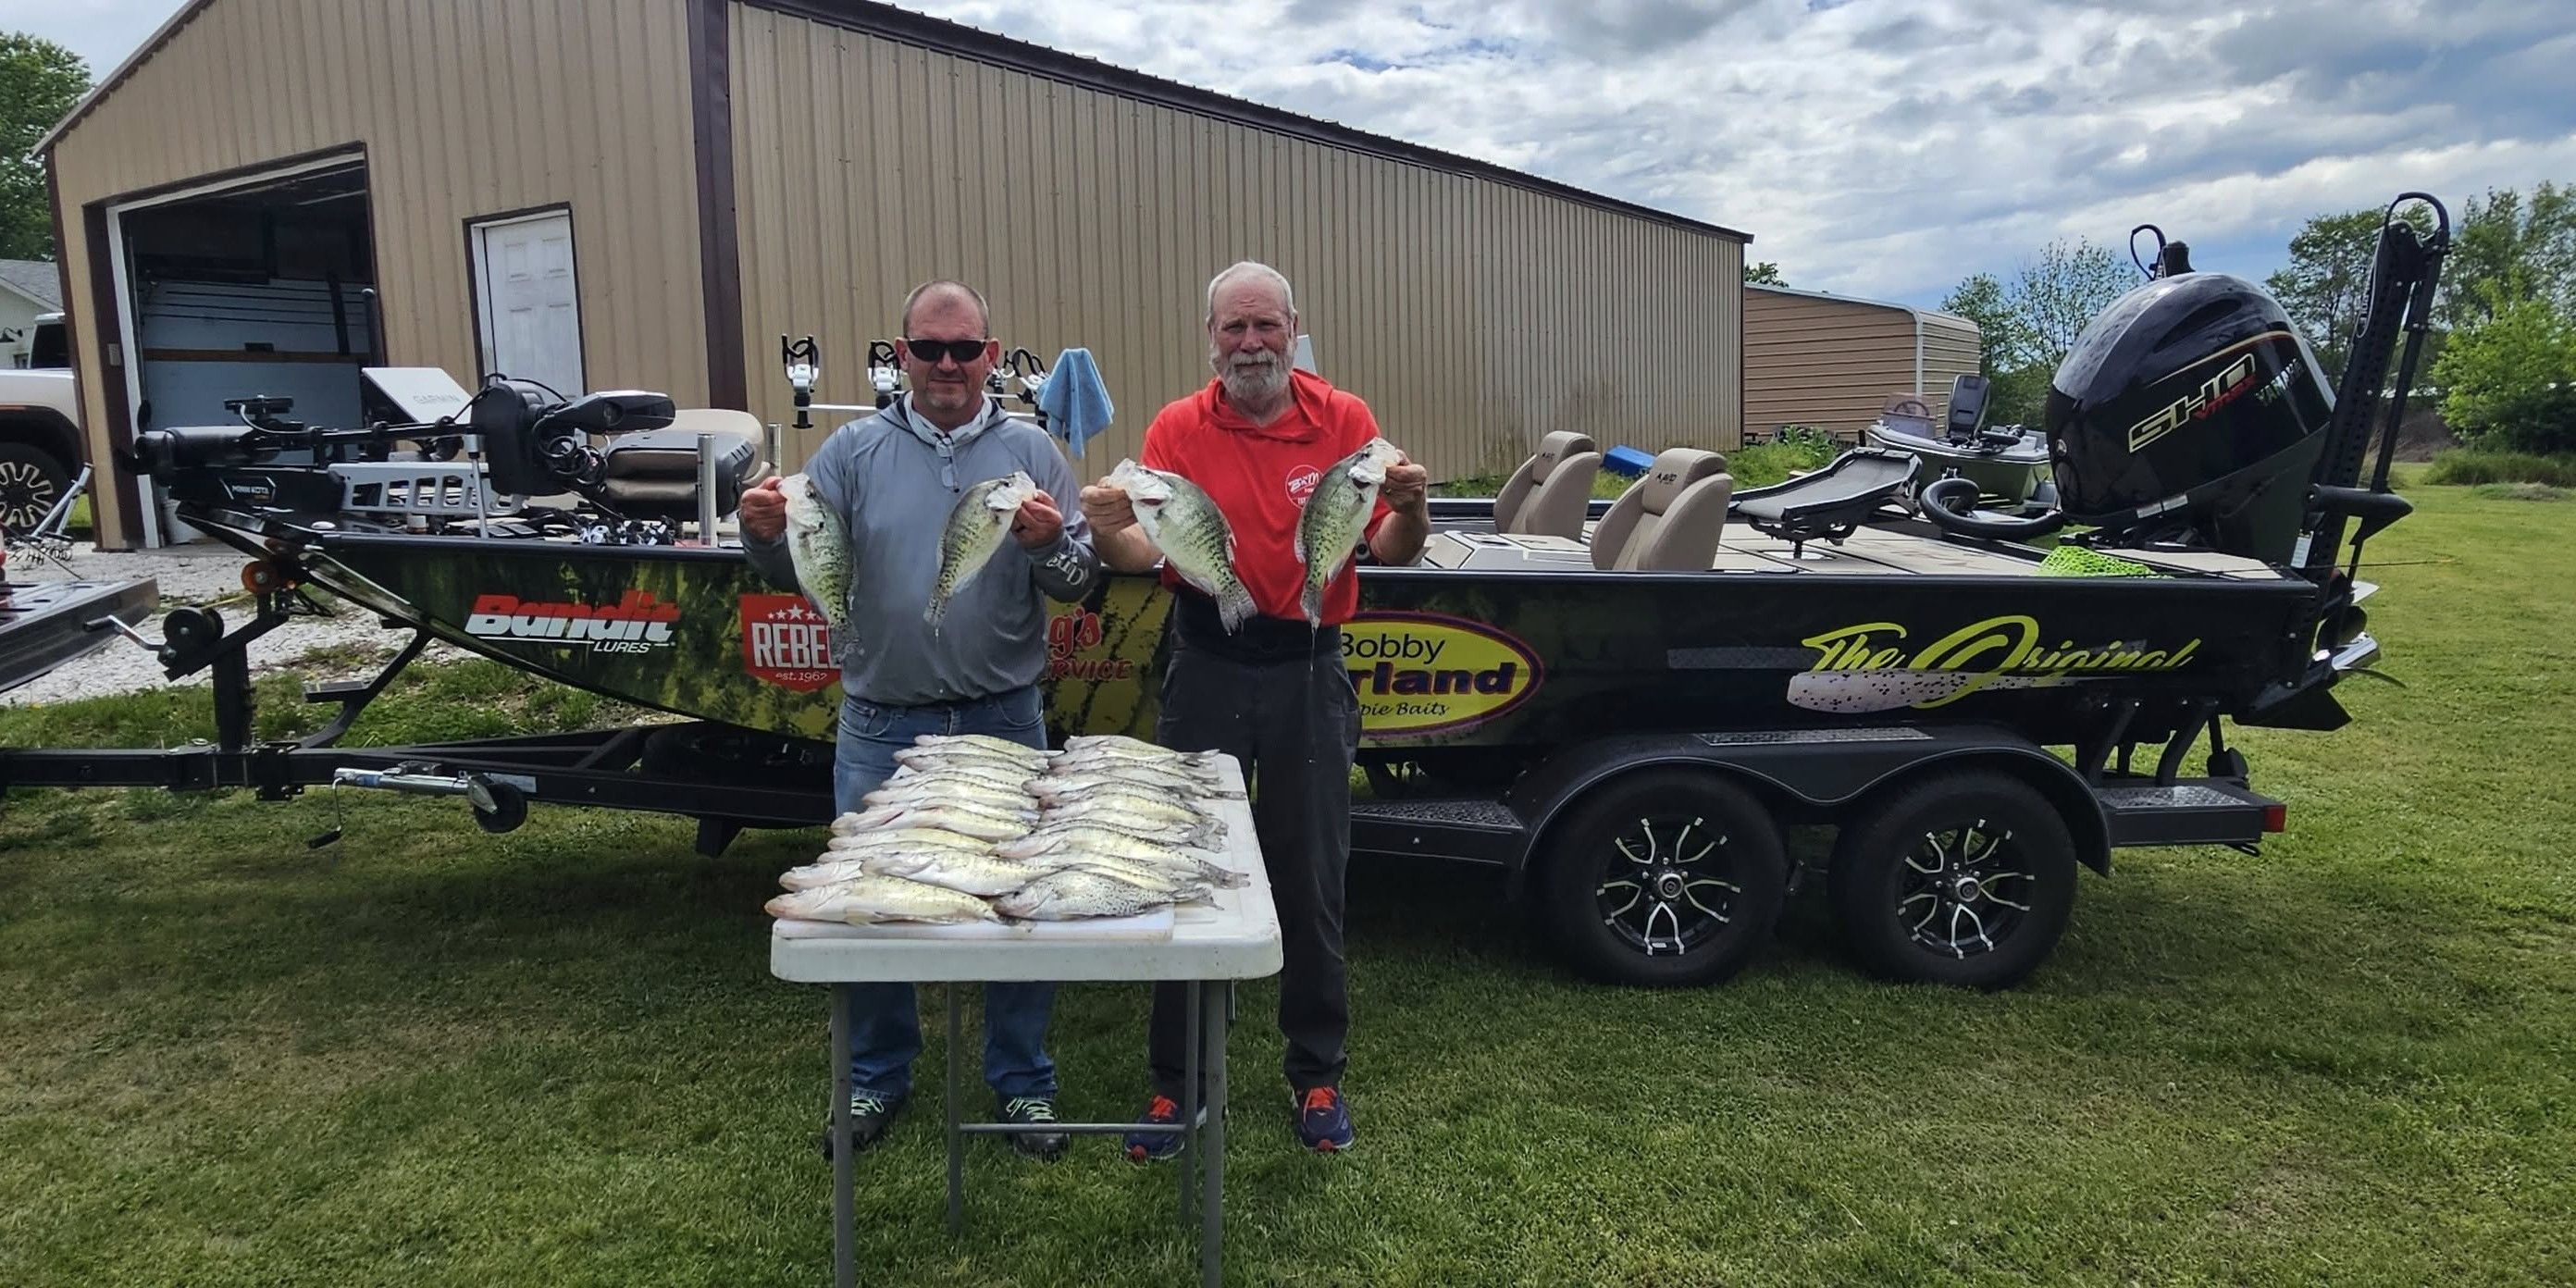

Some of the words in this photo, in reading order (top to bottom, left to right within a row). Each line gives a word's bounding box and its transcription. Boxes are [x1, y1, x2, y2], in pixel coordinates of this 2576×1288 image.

[2128, 353, 2256, 453] SHO
[464, 588, 681, 642] Bandit
[593, 641, 650, 654] LURES
[1047, 606, 1103, 660] g's
[1342, 633, 1445, 664] Bobby
[1043, 659, 1135, 681] RVICE
[1802, 622, 1907, 672] The
[1906, 614, 2202, 709] Original
[1347, 662, 1517, 695] rland
[1395, 701, 1450, 716] Baits
